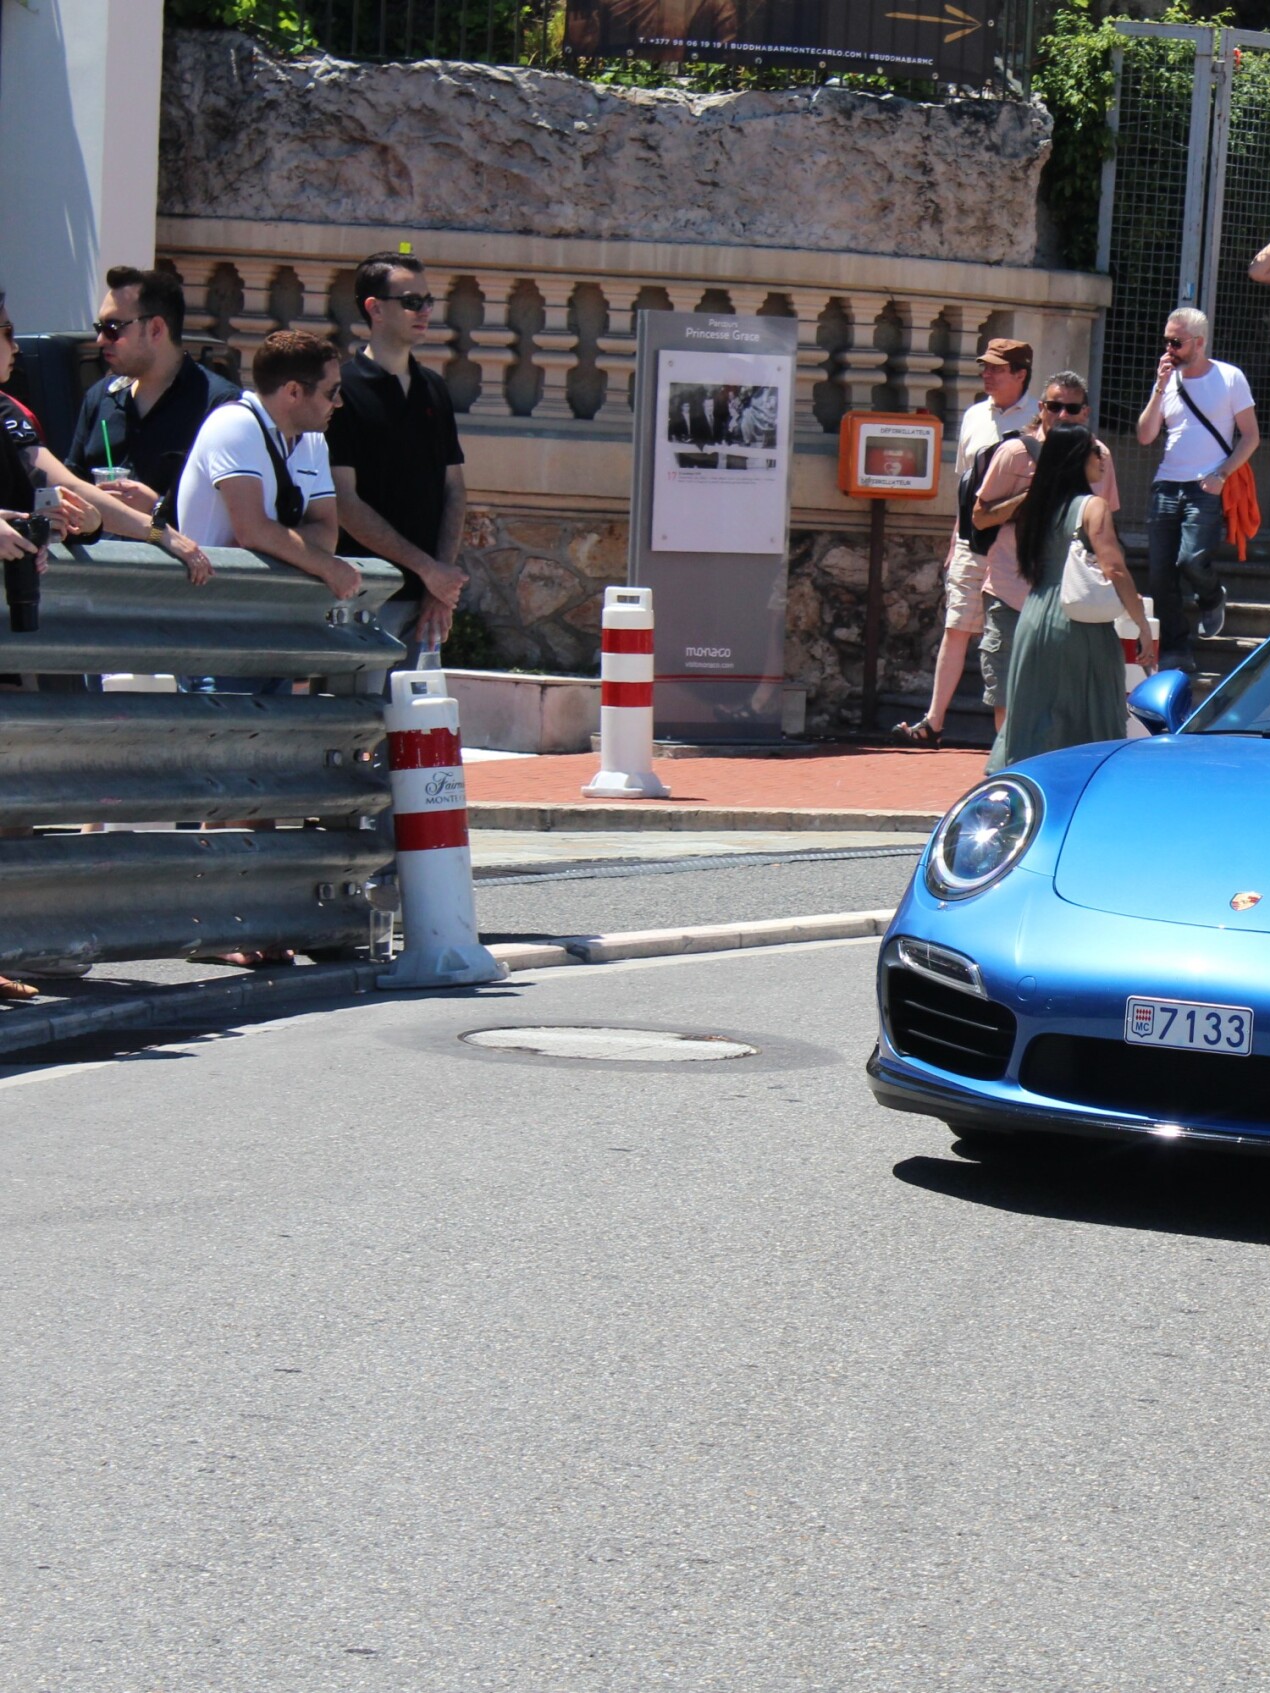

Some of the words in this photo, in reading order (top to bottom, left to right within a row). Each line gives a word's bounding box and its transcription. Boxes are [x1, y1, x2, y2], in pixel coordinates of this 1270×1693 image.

[731, 43, 861, 58] BUDDHABARMONTECARLO.COM
[869, 54, 934, 65] #BUDDHABARMC
[708, 319, 738, 328] Parcours
[686, 327, 730, 340] Princesse
[732, 330, 760, 342] Grace
[686, 647, 731, 658] monaco
[1135, 1021, 1150, 1032] MC
[1158, 1006, 1245, 1048] 7133
